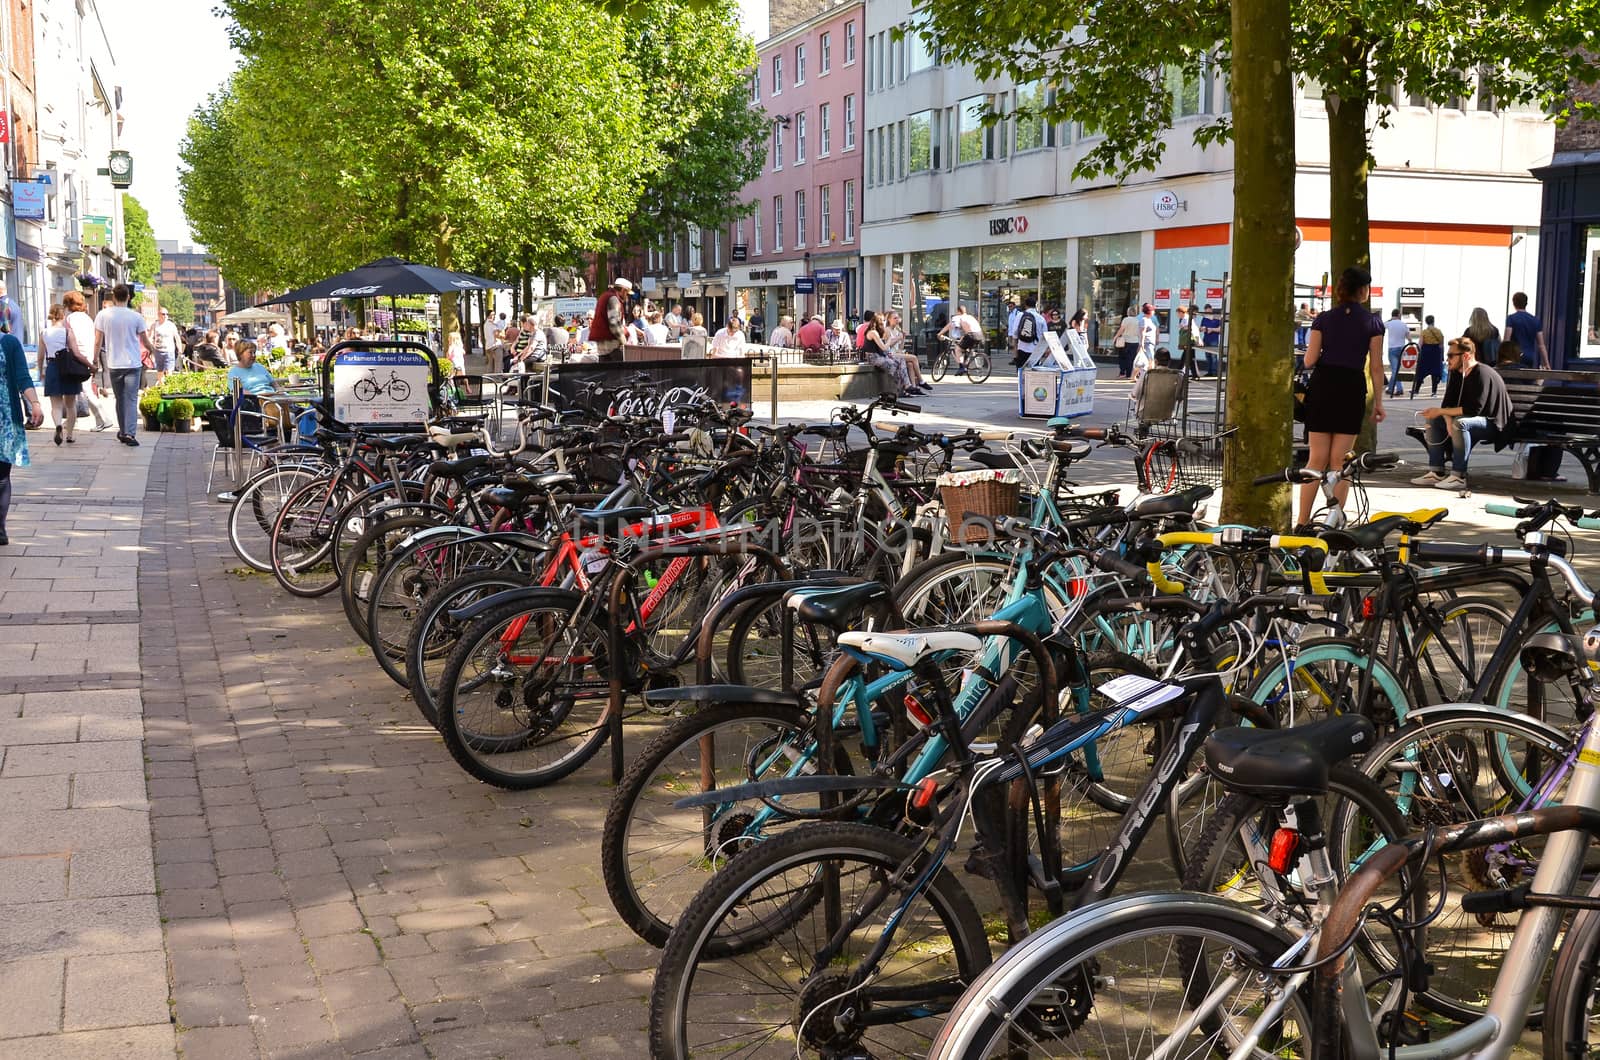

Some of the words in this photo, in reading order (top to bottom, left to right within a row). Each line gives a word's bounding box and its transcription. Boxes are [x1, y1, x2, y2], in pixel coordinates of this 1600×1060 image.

[1157, 203, 1176, 211] HSBC
[989, 217, 1014, 235] HSBC
[1094, 722, 1200, 892] ORBEA
